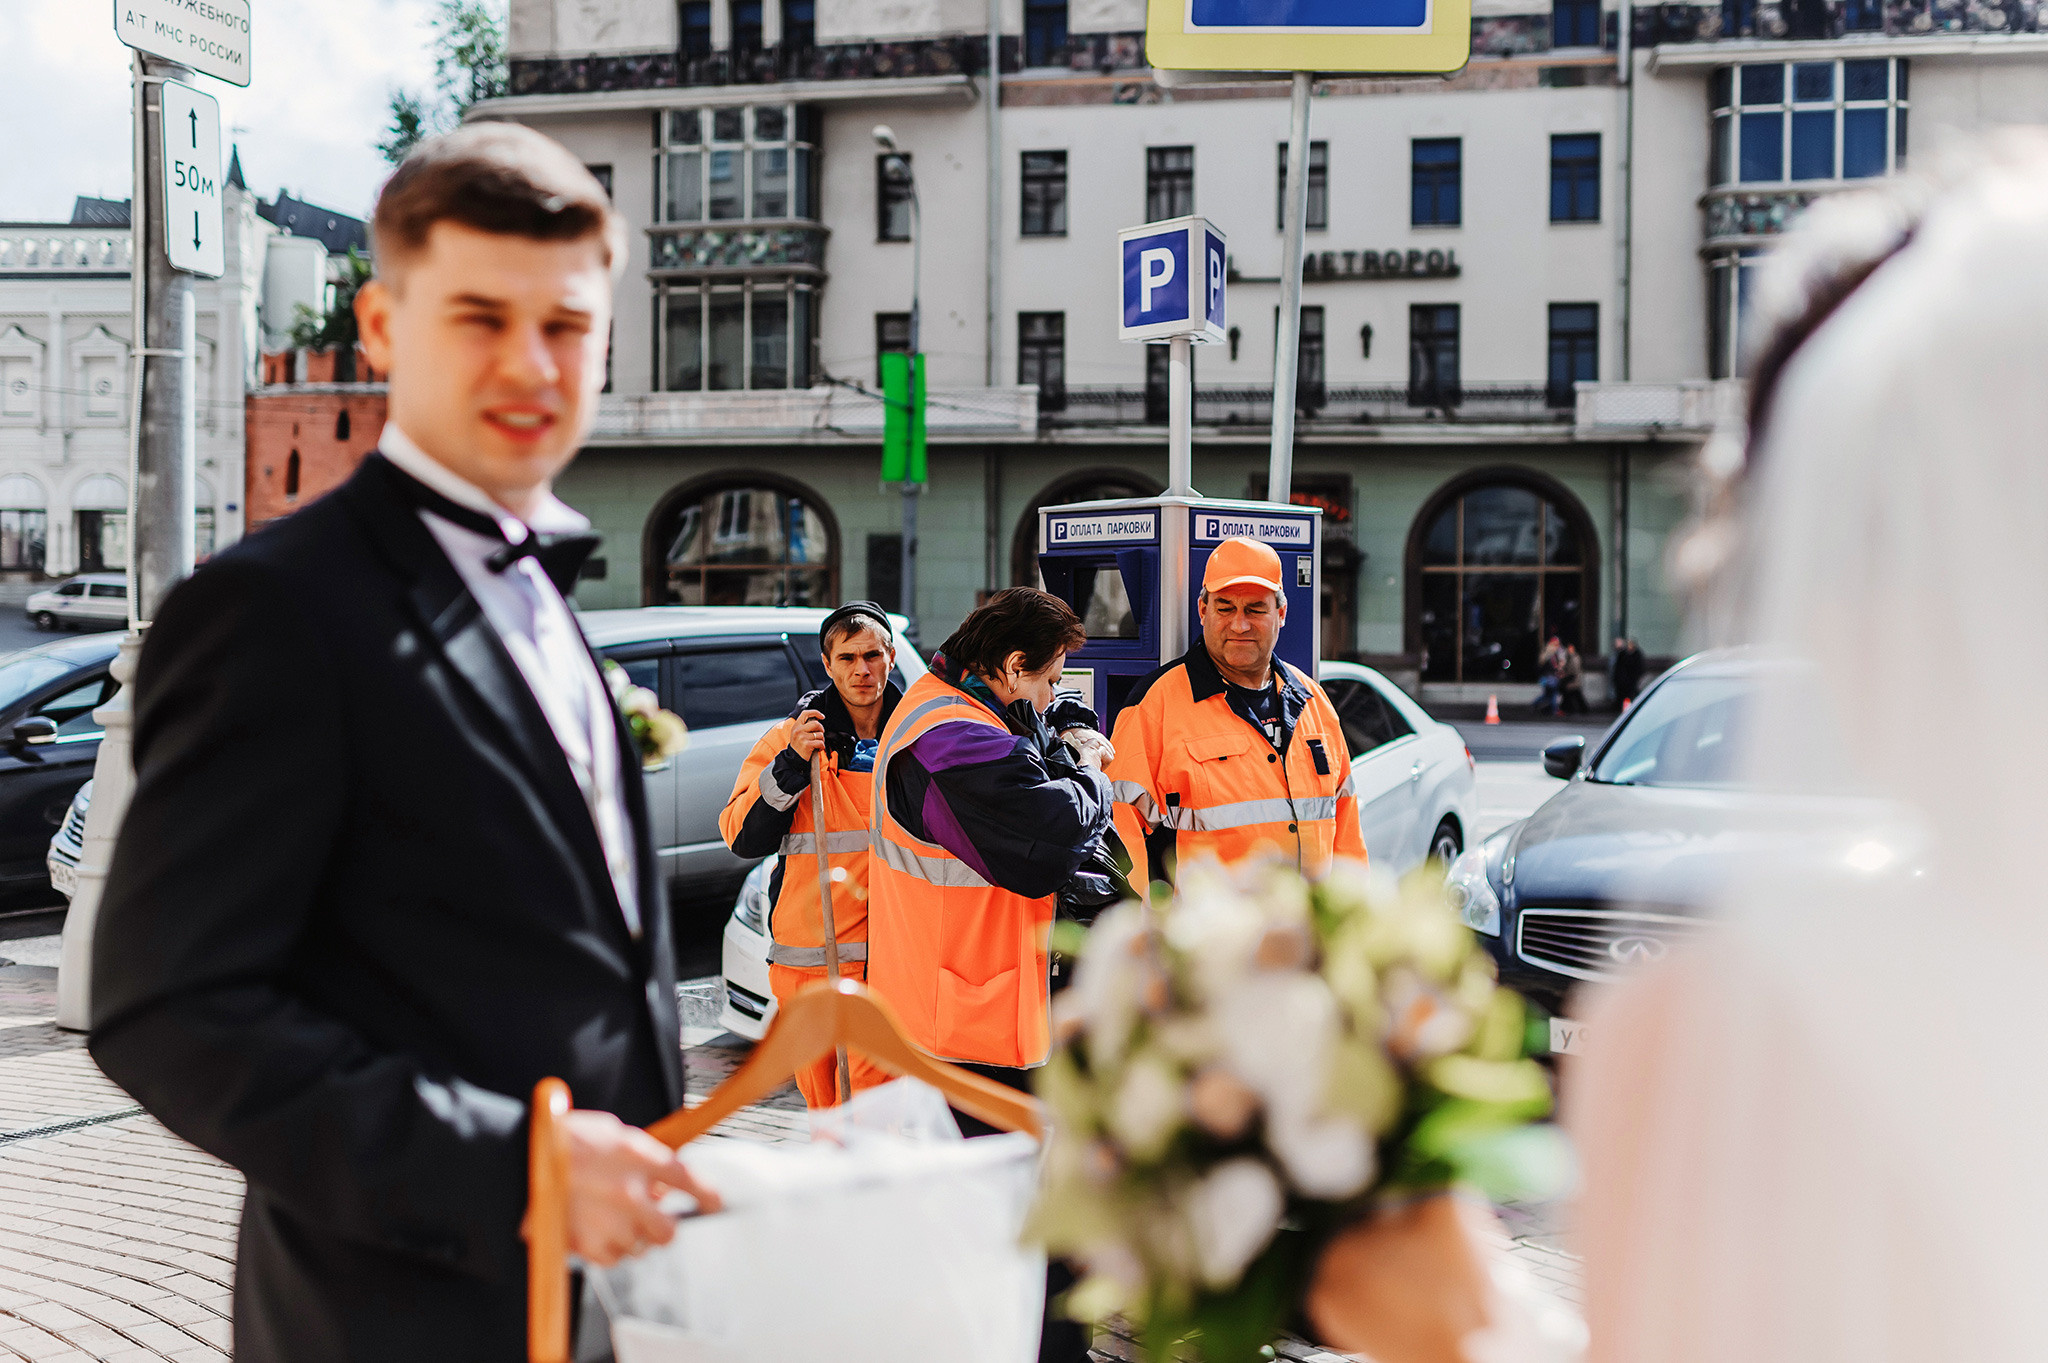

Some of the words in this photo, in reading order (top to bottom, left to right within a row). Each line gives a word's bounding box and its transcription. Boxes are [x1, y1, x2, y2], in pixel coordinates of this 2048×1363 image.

[165, 0, 249, 33] ЖЕБНОГО
[155, 21, 182, 43] МЧС
[190, 34, 242, 65] РОССИИ
[1141, 247, 1175, 313] P
[1210, 247, 1221, 310] P
[1070, 523, 1102, 536] ОПЛАТА
[1107, 521, 1152, 534] ПАРКОВКИ
[1222, 523, 1255, 536] ОПЛАТА
[1259, 524, 1300, 538] ПАРКОВКИ
